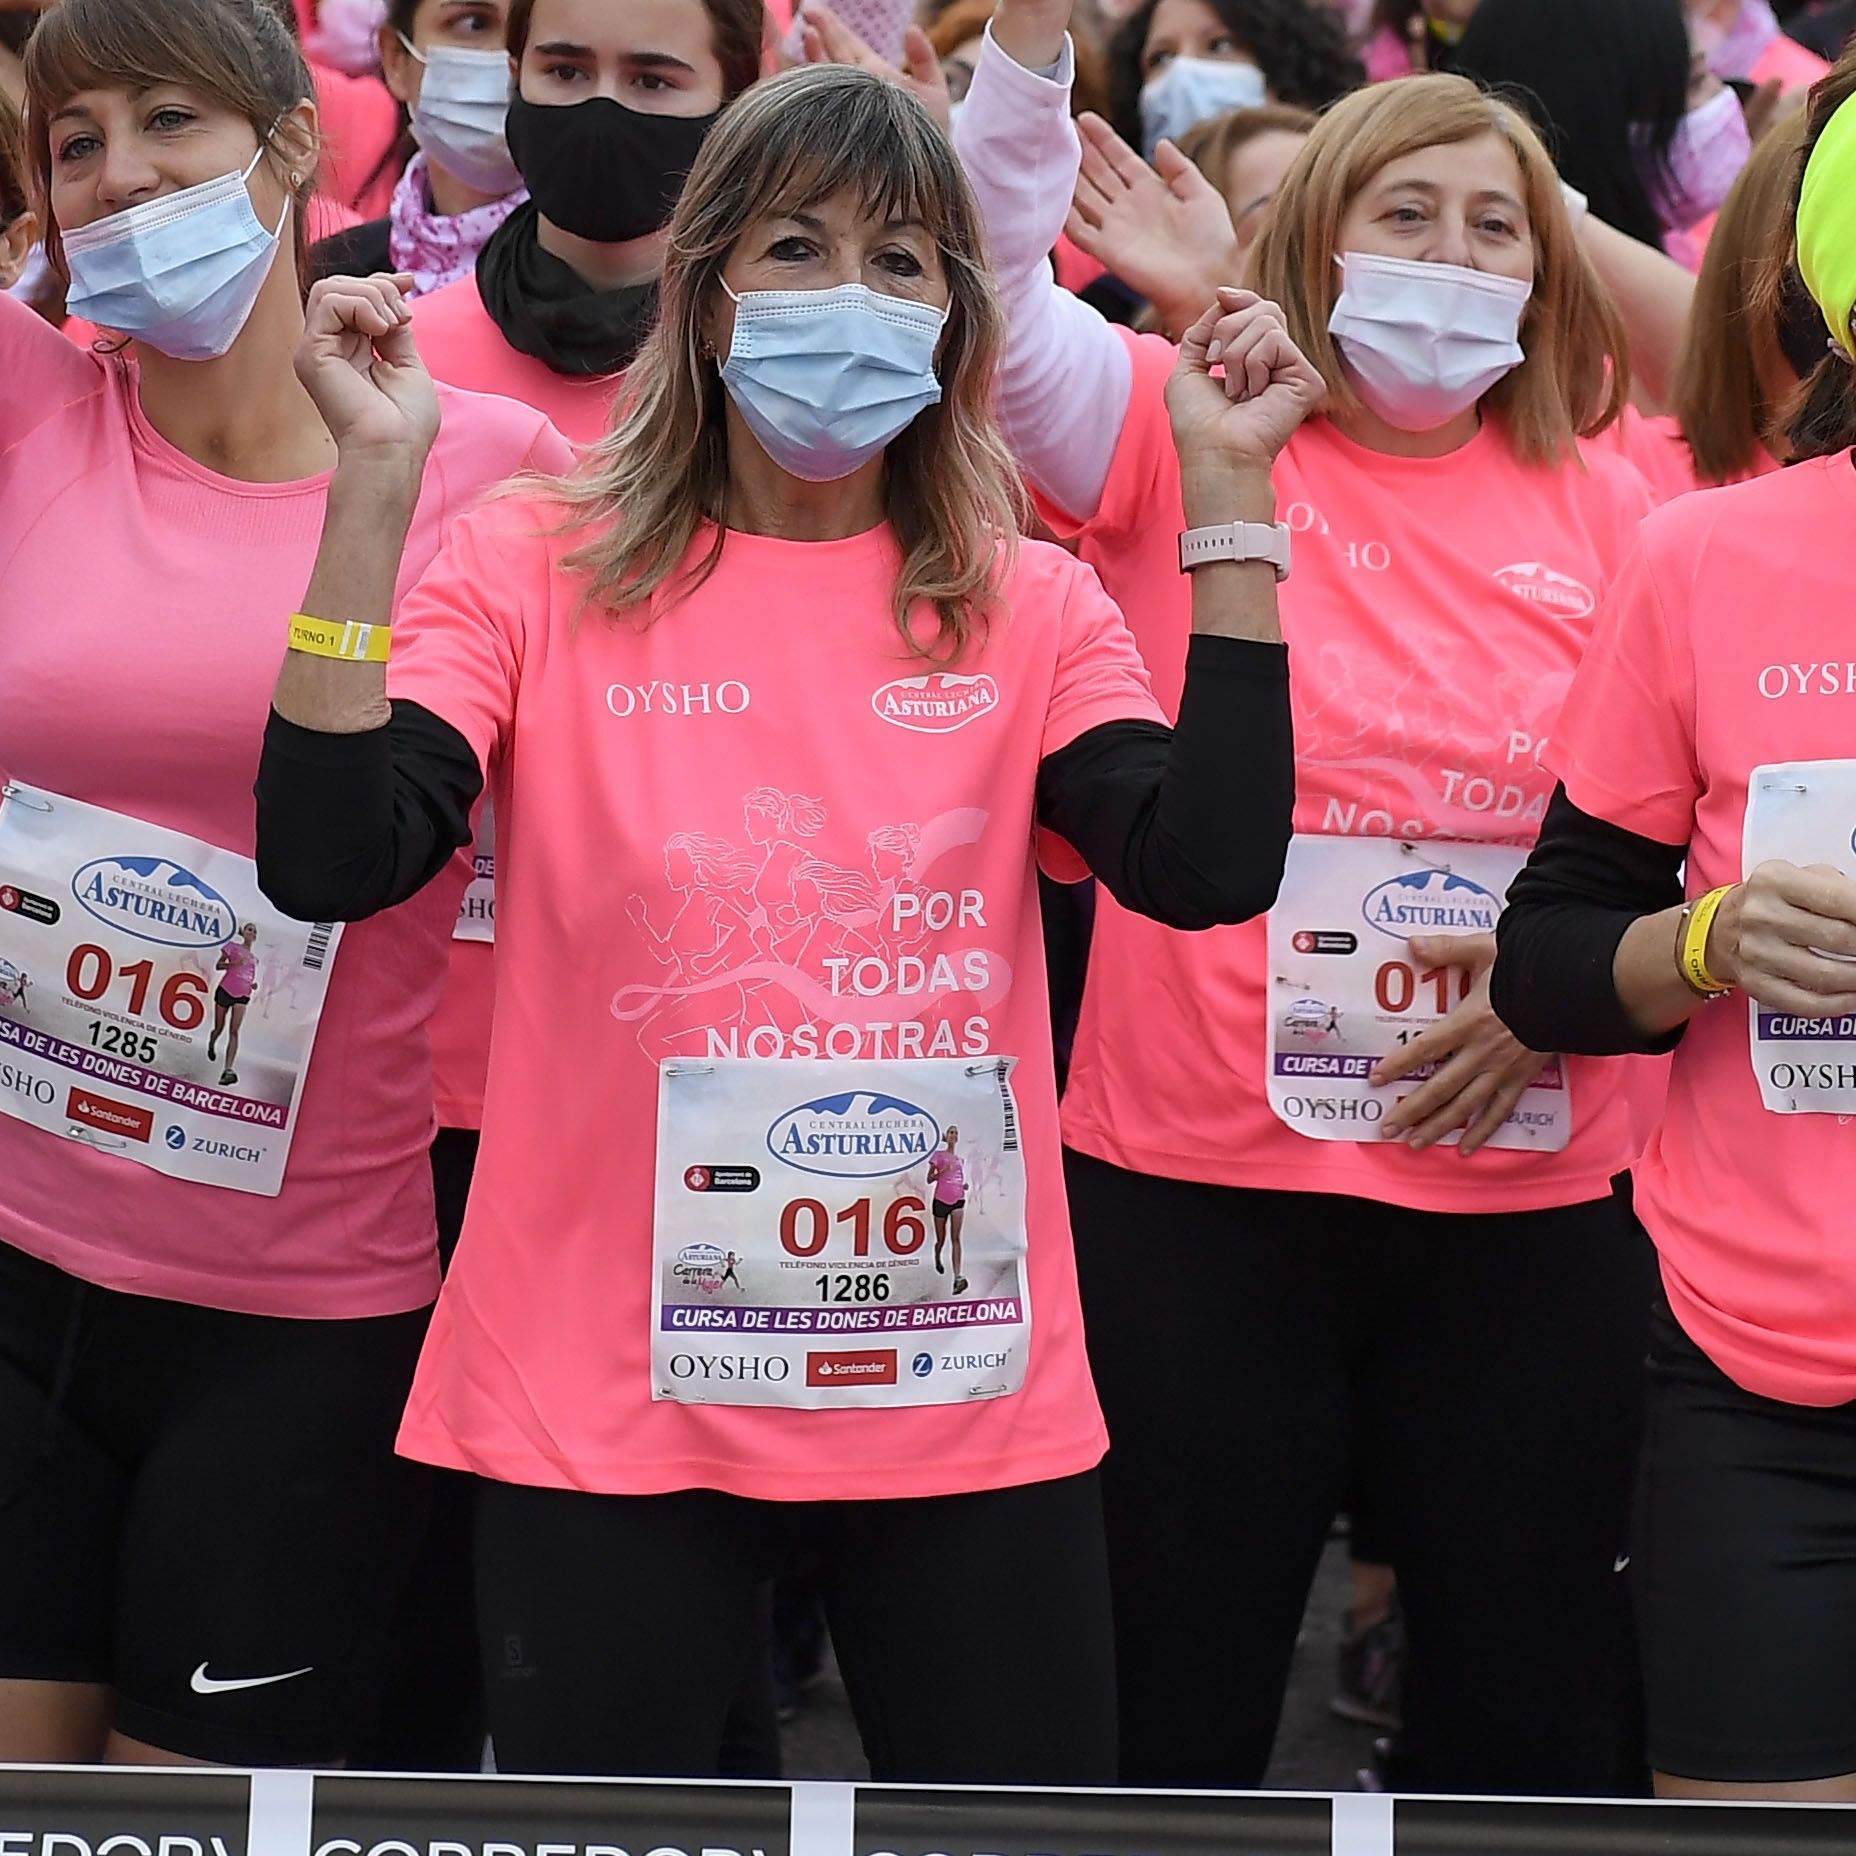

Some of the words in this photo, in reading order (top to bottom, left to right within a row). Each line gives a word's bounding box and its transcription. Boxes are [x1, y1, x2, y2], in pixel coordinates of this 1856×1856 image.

[294, 627, 326, 645] TURNO
[607, 680, 750, 717] OYSHO
[884, 691, 992, 717] ASTURIANA
[1441, 769, 1545, 823] TODA
[82, 872, 221, 939] ASTURIANA
[892, 890, 986, 931] POR
[1375, 895, 1493, 928] ASTURIANA
[66, 943, 209, 1030] 016
[822, 952, 989, 996] TODAS
[88, 1020, 158, 1064] 1285
[706, 1018, 990, 1059] NOSOTRAS
[1770, 1016, 1833, 1035] CURSA
[24, 1032, 46, 1052] DE
[49, 1040, 79, 1066] LES
[83, 1054, 141, 1087] DONES
[144, 1073, 167, 1093] DE
[171, 1082, 282, 1125] BARCELONA
[1283, 1056, 1339, 1073] CURSA
[1344, 1057, 1365, 1075] DE
[809, 1120, 866, 1130] CENTRAL
[1284, 1096, 1383, 1122] OYSHO
[90, 1104, 142, 1130] Santander
[192, 1138, 260, 1163] ZURICH
[781, 1122, 928, 1155] ASTURIANA
[780, 1195, 926, 1258] 016
[816, 1273, 890, 1302] 1286
[672, 1308, 738, 1329] CURSA
[743, 1309, 768, 1328] DE
[774, 1309, 812, 1329] LES
[816, 1309, 879, 1329] DONES
[884, 1308, 908, 1326] DE
[912, 1301, 1017, 1326] BARCELONA
[670, 1354, 789, 1382] OYSHO
[833, 1361, 887, 1375] Santander
[941, 1352, 1007, 1371] ZURICH
